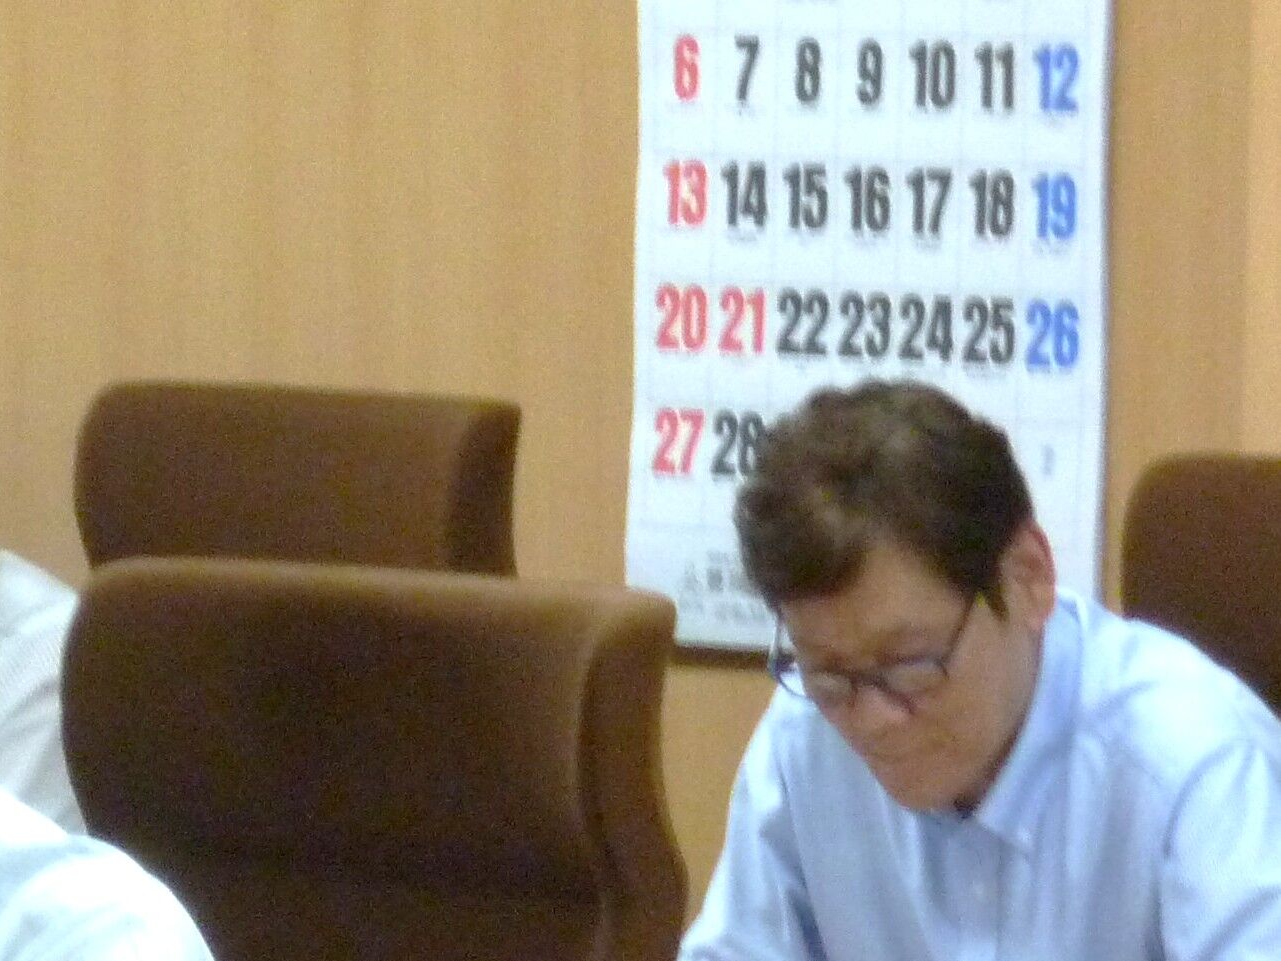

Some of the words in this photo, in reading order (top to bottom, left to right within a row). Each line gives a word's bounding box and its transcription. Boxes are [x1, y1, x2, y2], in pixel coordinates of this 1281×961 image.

[674, 35, 699, 100] 6
[734, 34, 761, 104] 7
[794, 36, 823, 109] 8
[856, 38, 884, 111] 9
[909, 38, 957, 114] 10
[974, 41, 1016, 115] 11
[1032, 41, 1081, 114] 12
[664, 160, 707, 225] 13
[720, 159, 769, 232] 14
[782, 162, 829, 237] 15
[843, 164, 892, 239] 16
[905, 166, 954, 240] 17
[968, 168, 1016, 243] 18
[1031, 170, 1079, 243] 19
[656, 283, 707, 352] 20
[718, 287, 765, 353] 21
[775, 286, 832, 362] 22
[836, 289, 894, 365] 23
[897, 291, 955, 368] 24
[961, 294, 1018, 369] 25
[1022, 296, 1082, 373] 26
[652, 408, 704, 475] 27
[711, 410, 766, 477] 28
